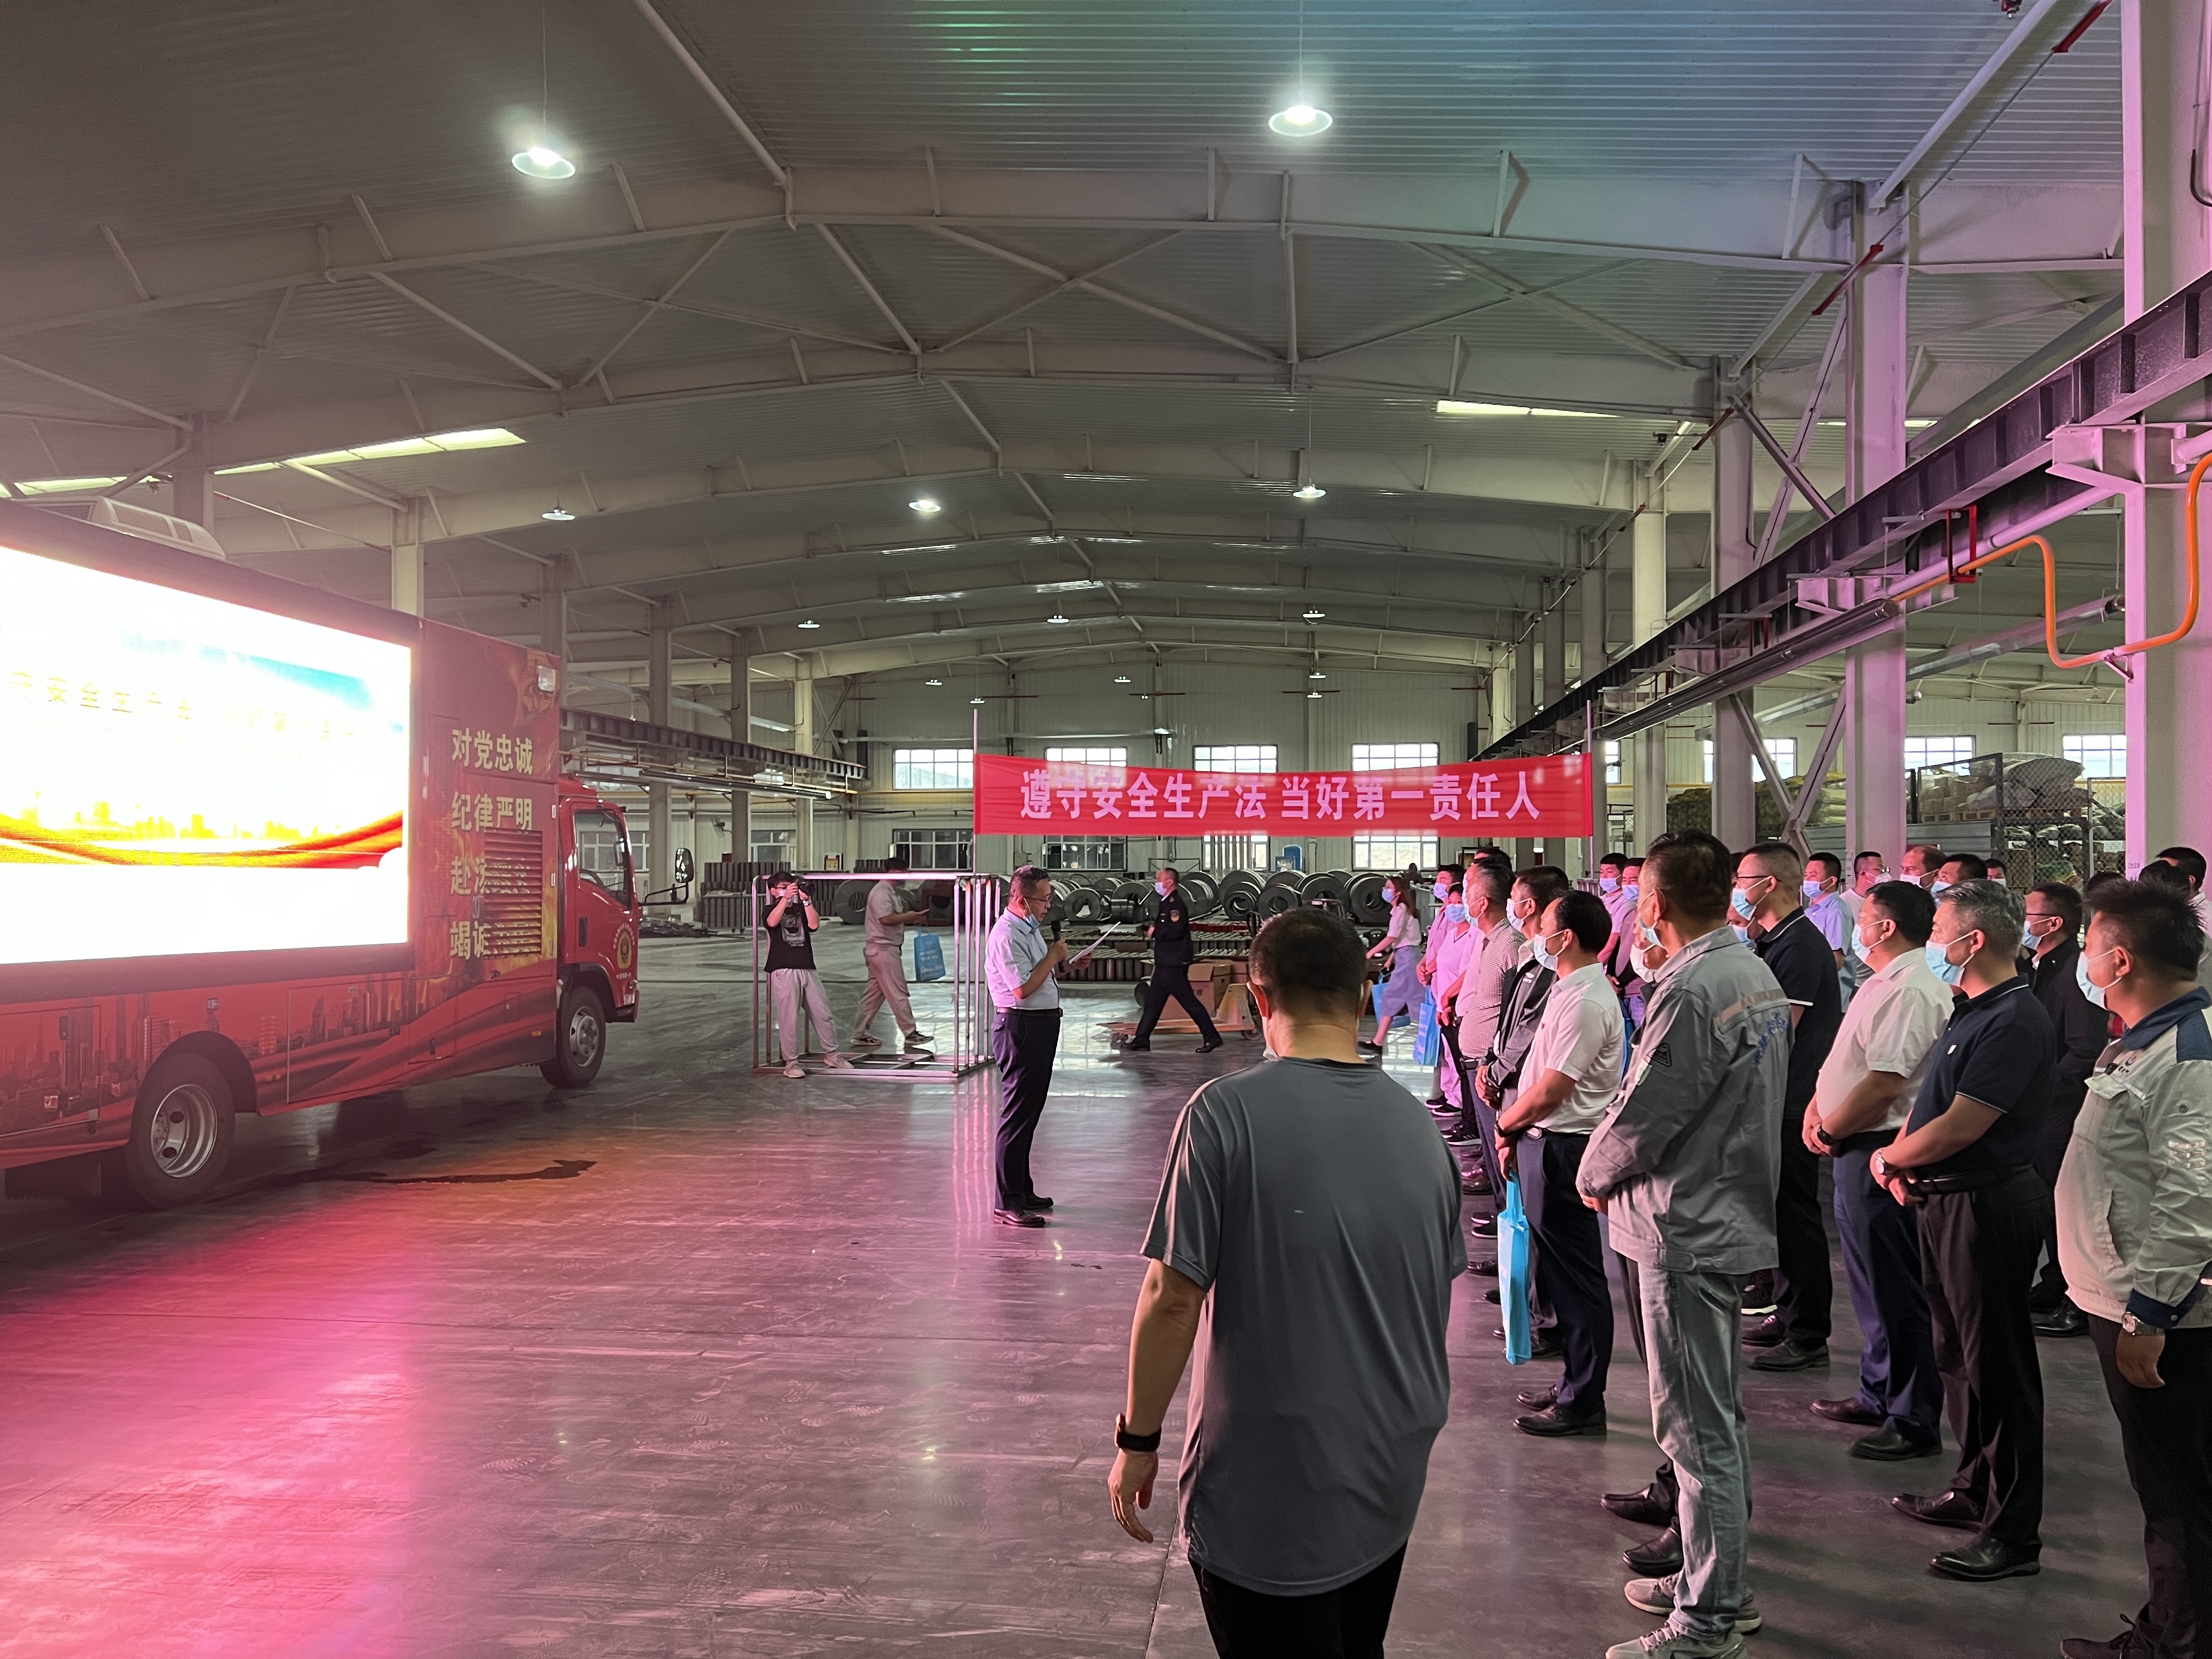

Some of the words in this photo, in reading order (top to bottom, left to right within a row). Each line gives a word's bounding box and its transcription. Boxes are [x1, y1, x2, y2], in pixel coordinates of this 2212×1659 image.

[452, 727, 533, 775] 对党忠诚
[452, 791, 533, 833] 纪律严明
[1020, 768, 1267, 820] 遵守安全生产法
[1281, 771, 1541, 821] 当好第一责任人
